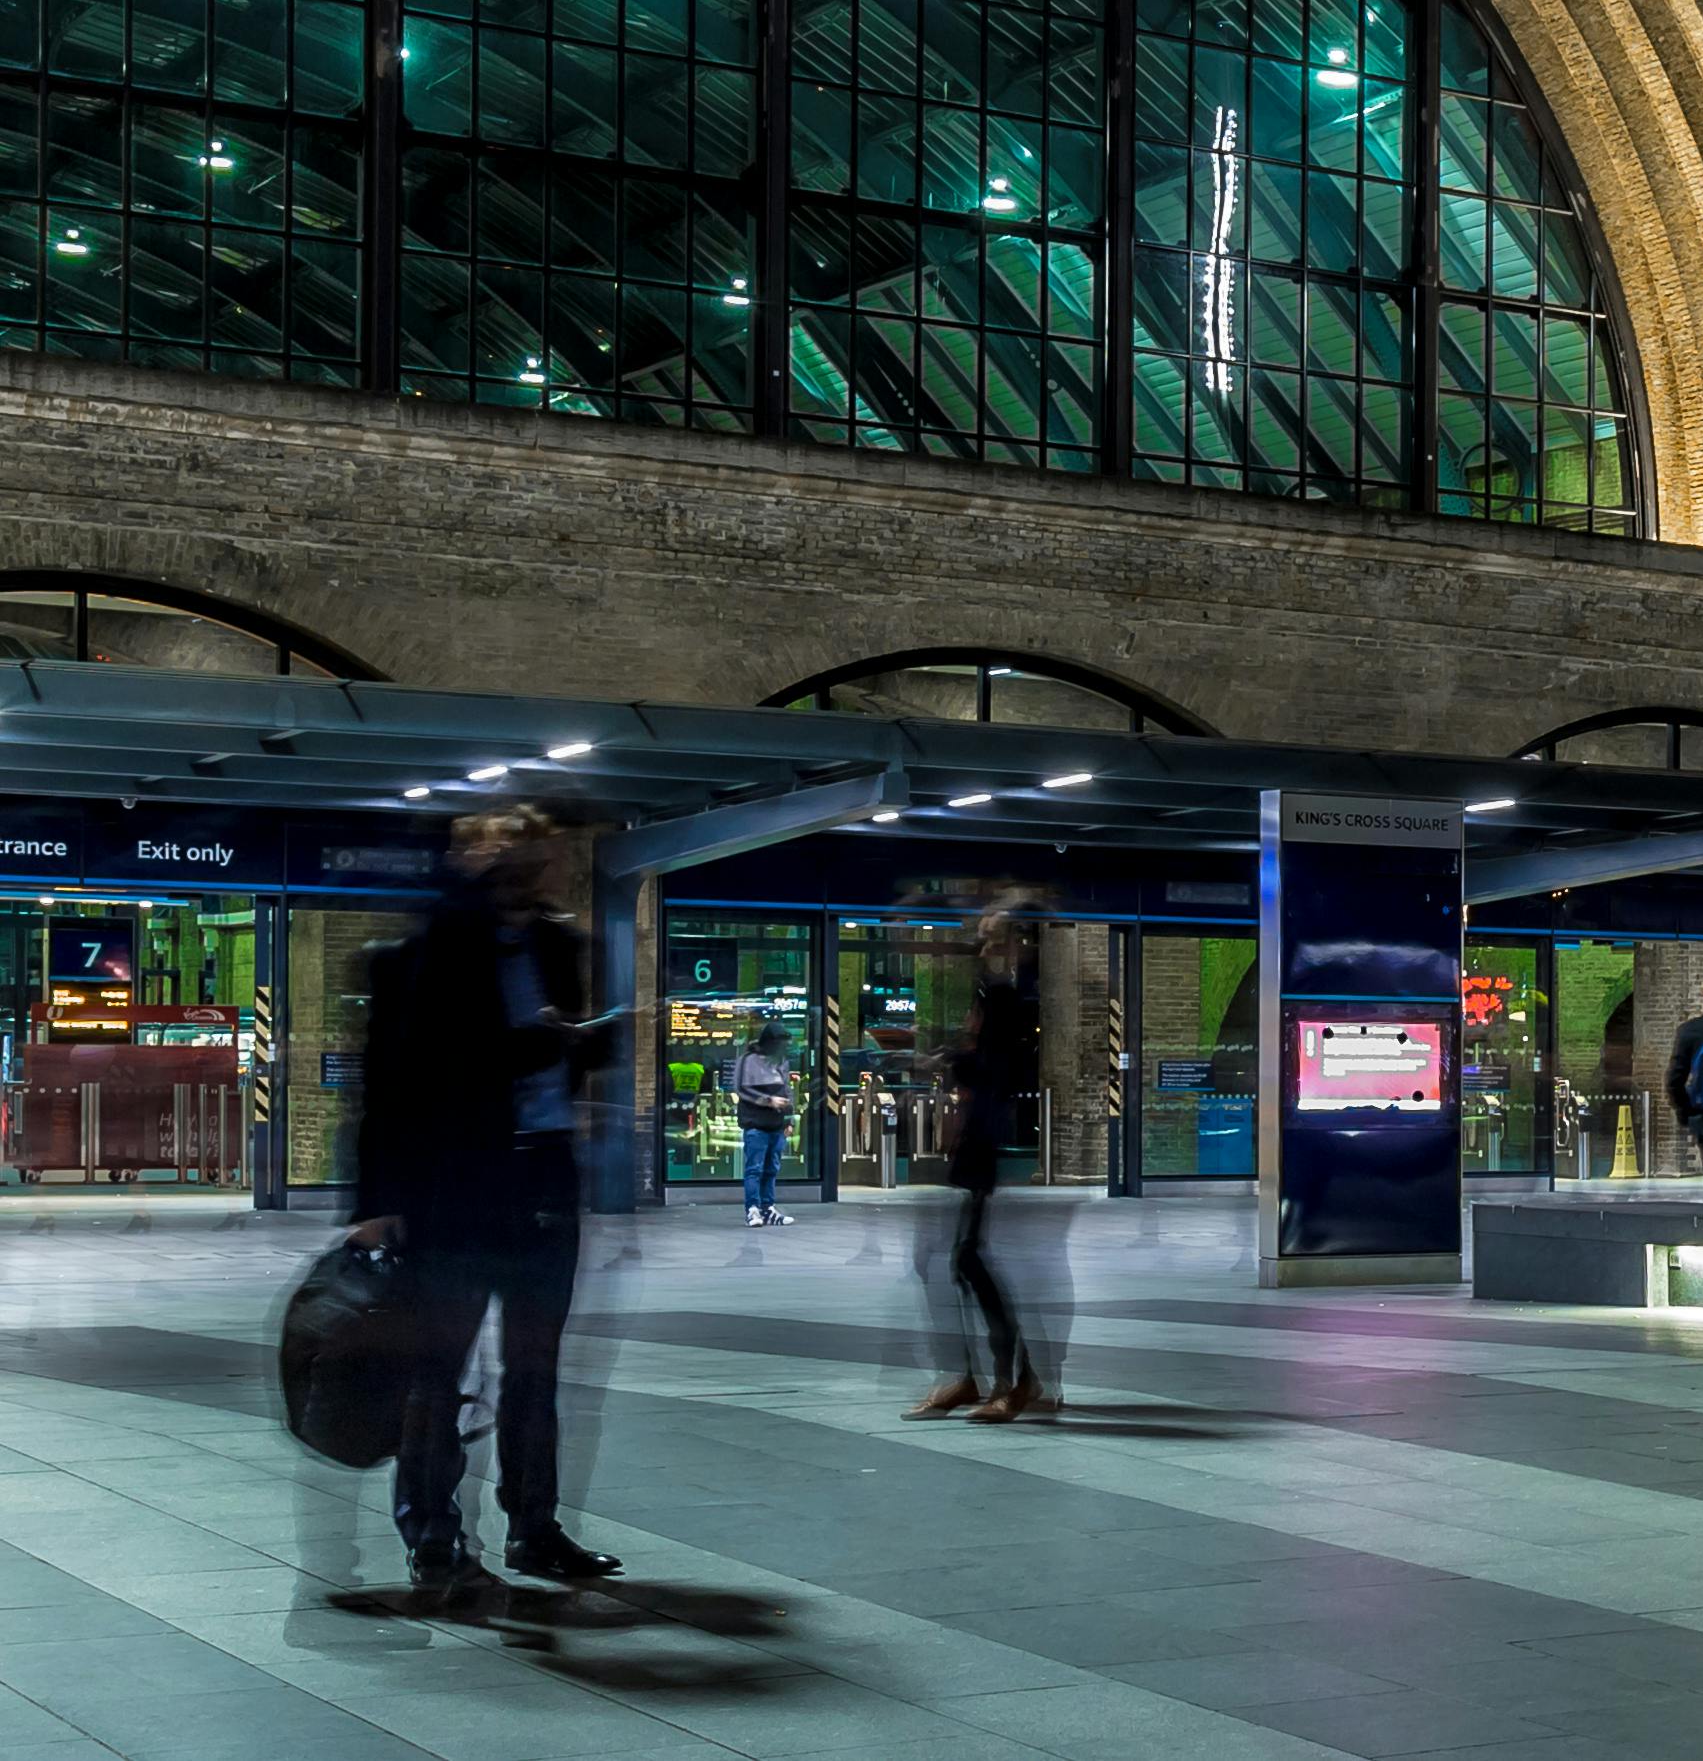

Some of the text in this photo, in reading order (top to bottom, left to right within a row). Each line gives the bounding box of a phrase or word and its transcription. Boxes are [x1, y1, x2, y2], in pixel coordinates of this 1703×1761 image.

[1295, 811, 1449, 831] KING'S CROSS SQUARE
[137, 840, 234, 866] Exit only
[81, 942, 102, 967] 7
[694, 959, 712, 983] 6
